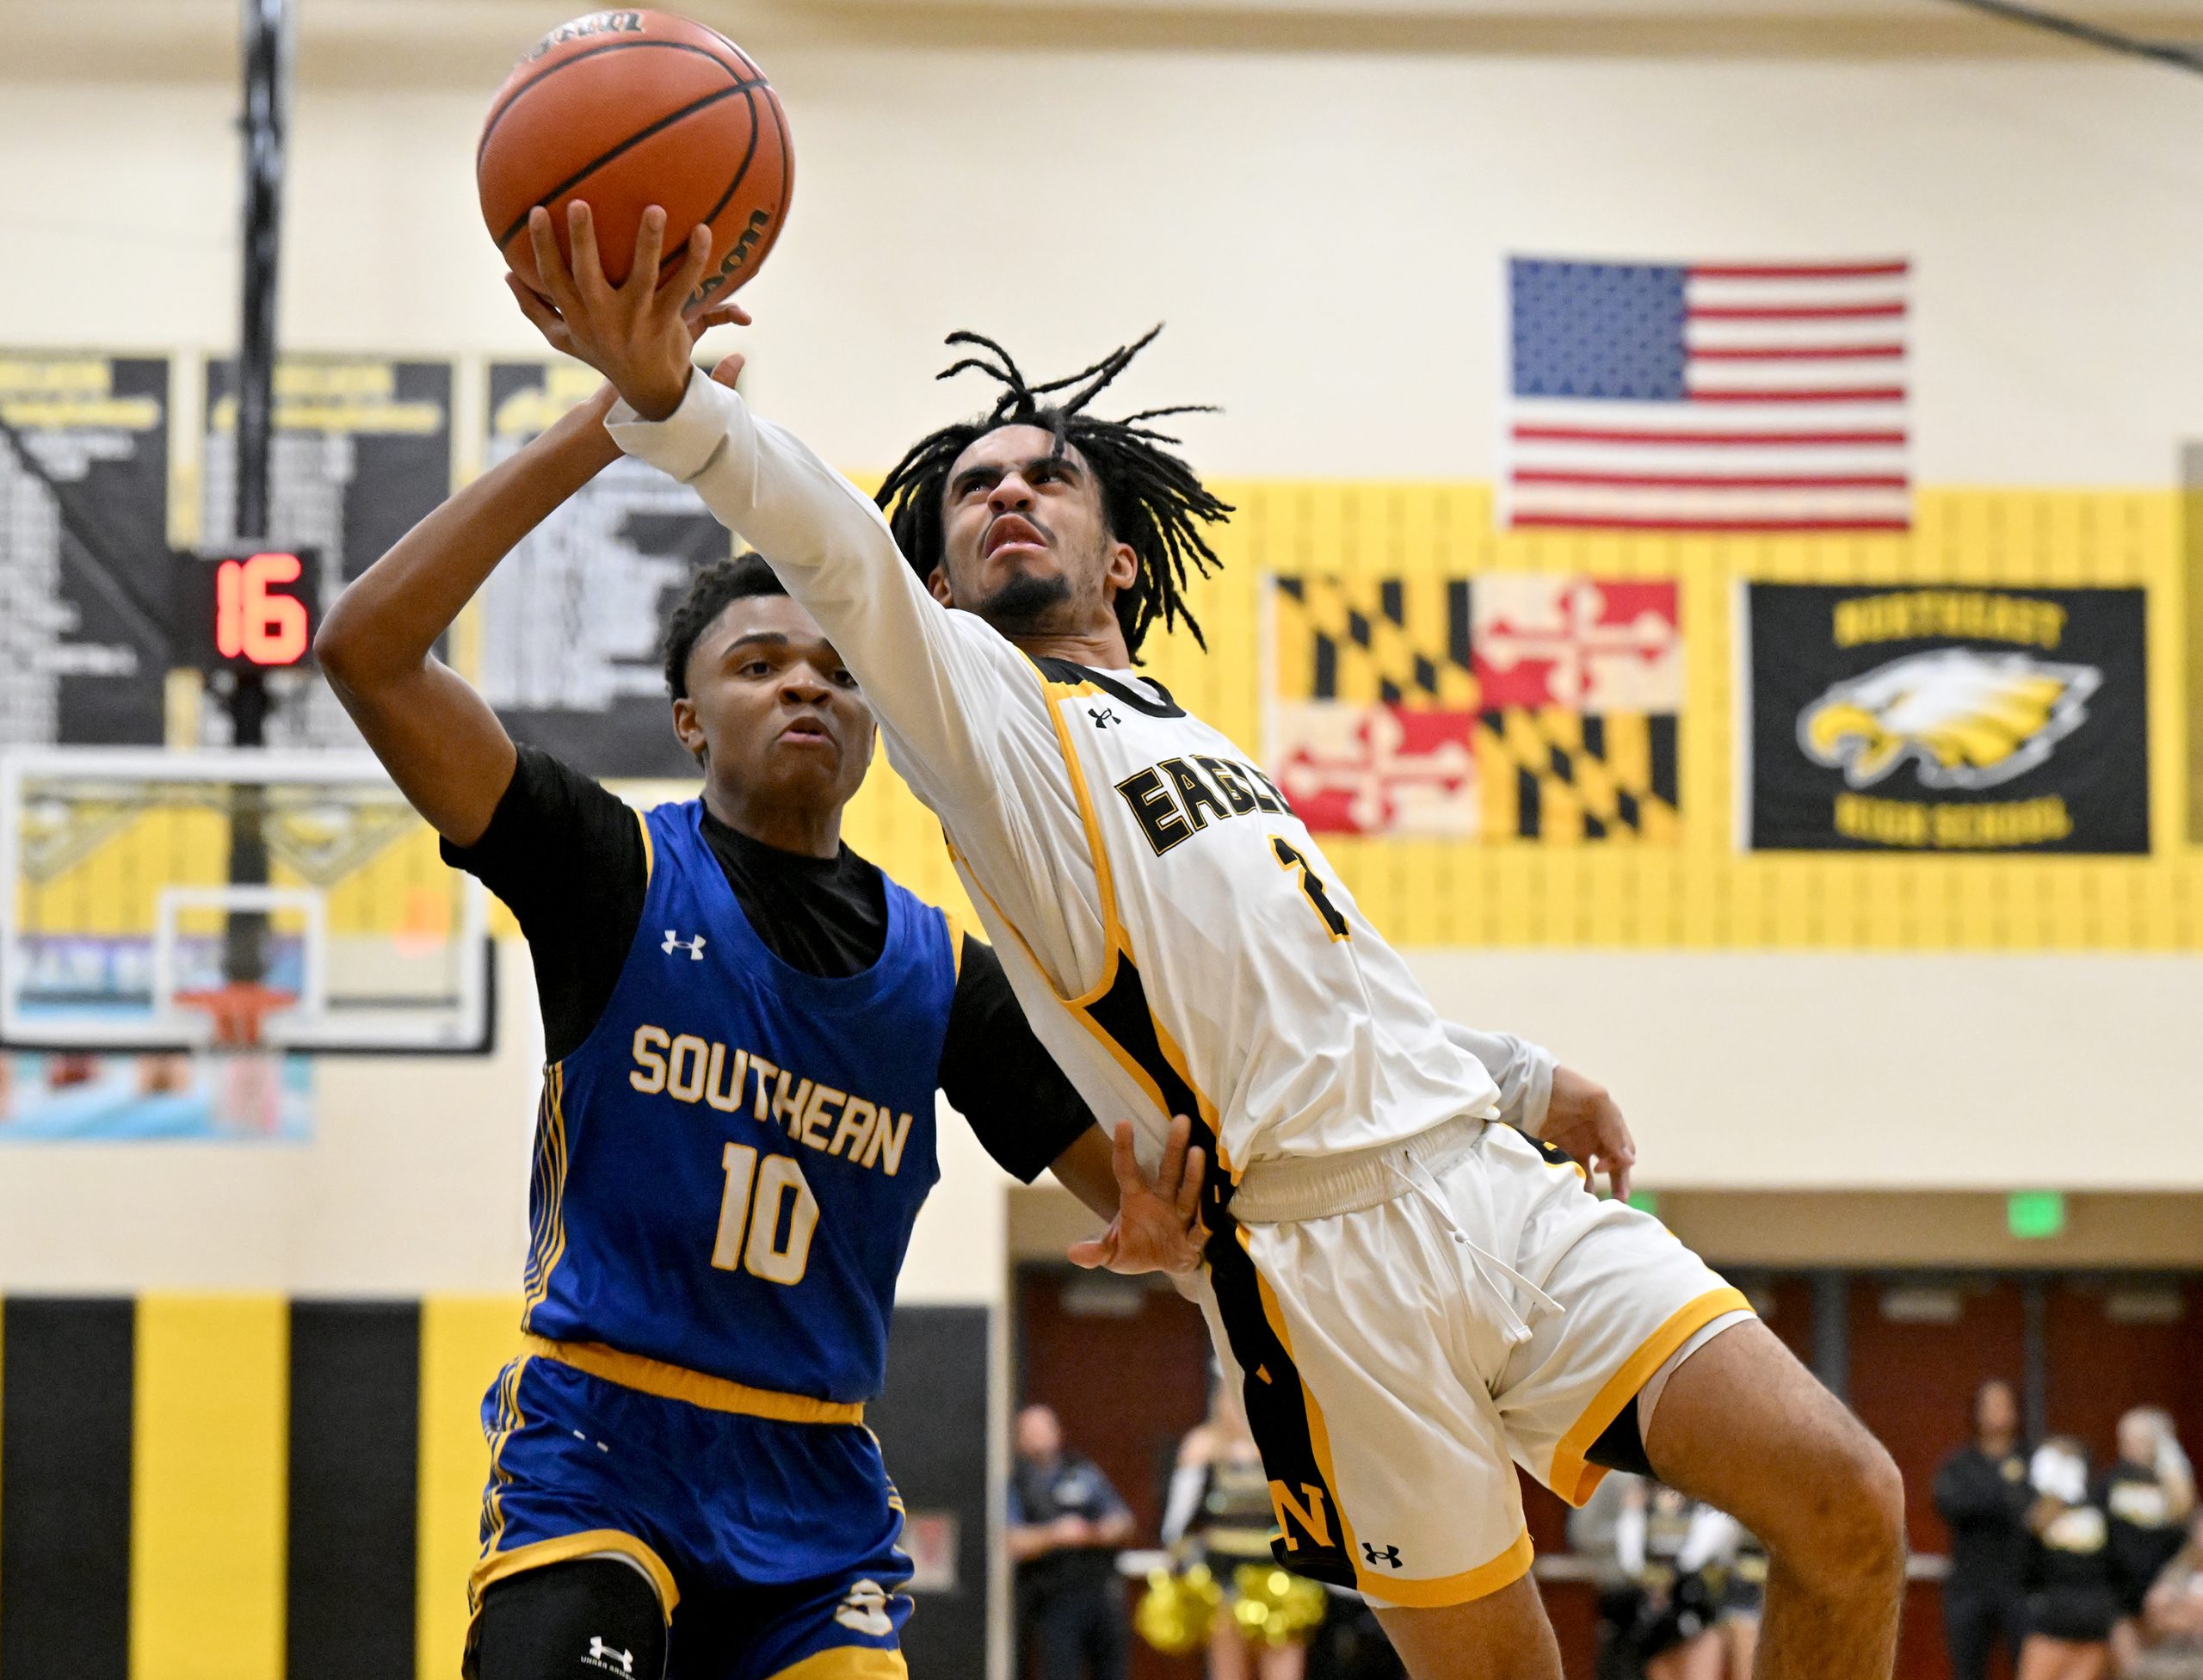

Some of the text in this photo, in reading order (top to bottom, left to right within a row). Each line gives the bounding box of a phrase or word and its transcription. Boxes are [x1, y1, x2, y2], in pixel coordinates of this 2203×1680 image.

[217, 553, 308, 665] 16
[629, 1024, 913, 1177] SOUTHERN
[711, 1141, 820, 1286] 10
[1268, 1479, 1336, 1551] N
